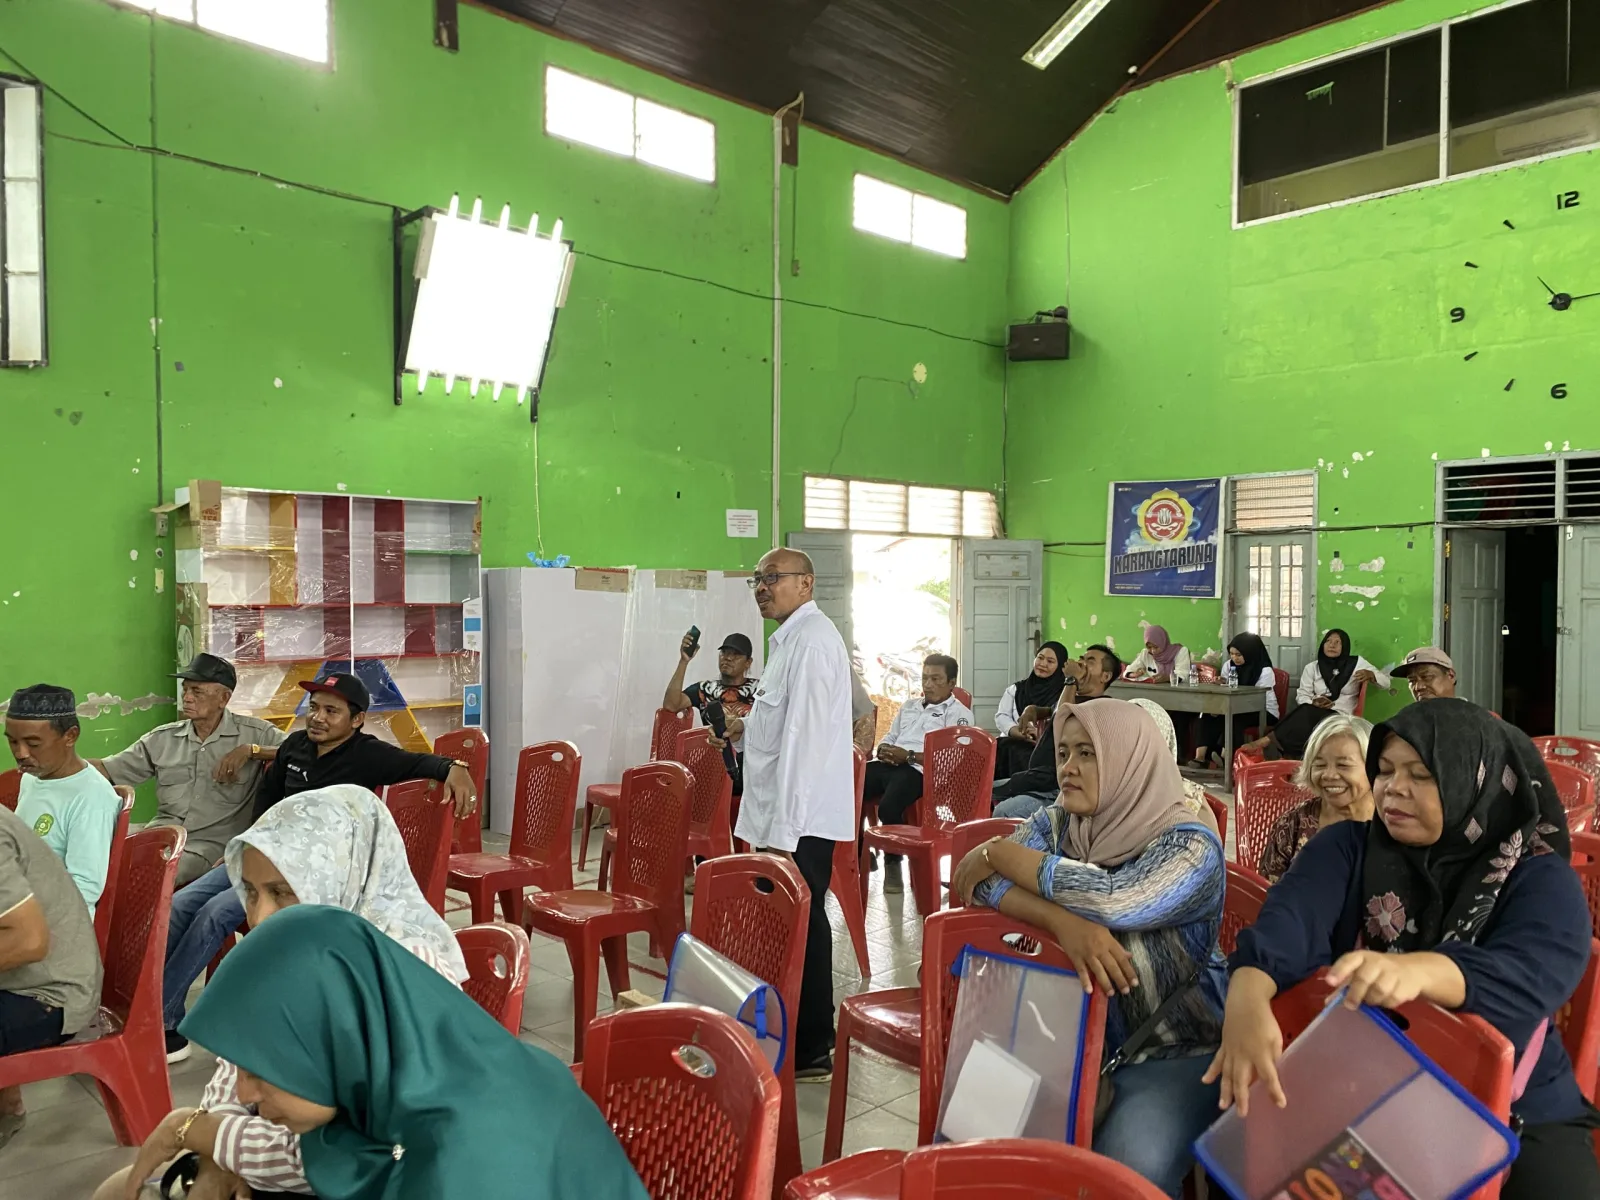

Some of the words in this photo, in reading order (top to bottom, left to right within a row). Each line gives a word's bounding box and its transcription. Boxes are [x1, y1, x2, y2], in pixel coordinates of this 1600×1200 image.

[1557, 191, 1580, 210] 12
[1450, 307, 1466, 323] 9
[1550, 383, 1567, 399] 6
